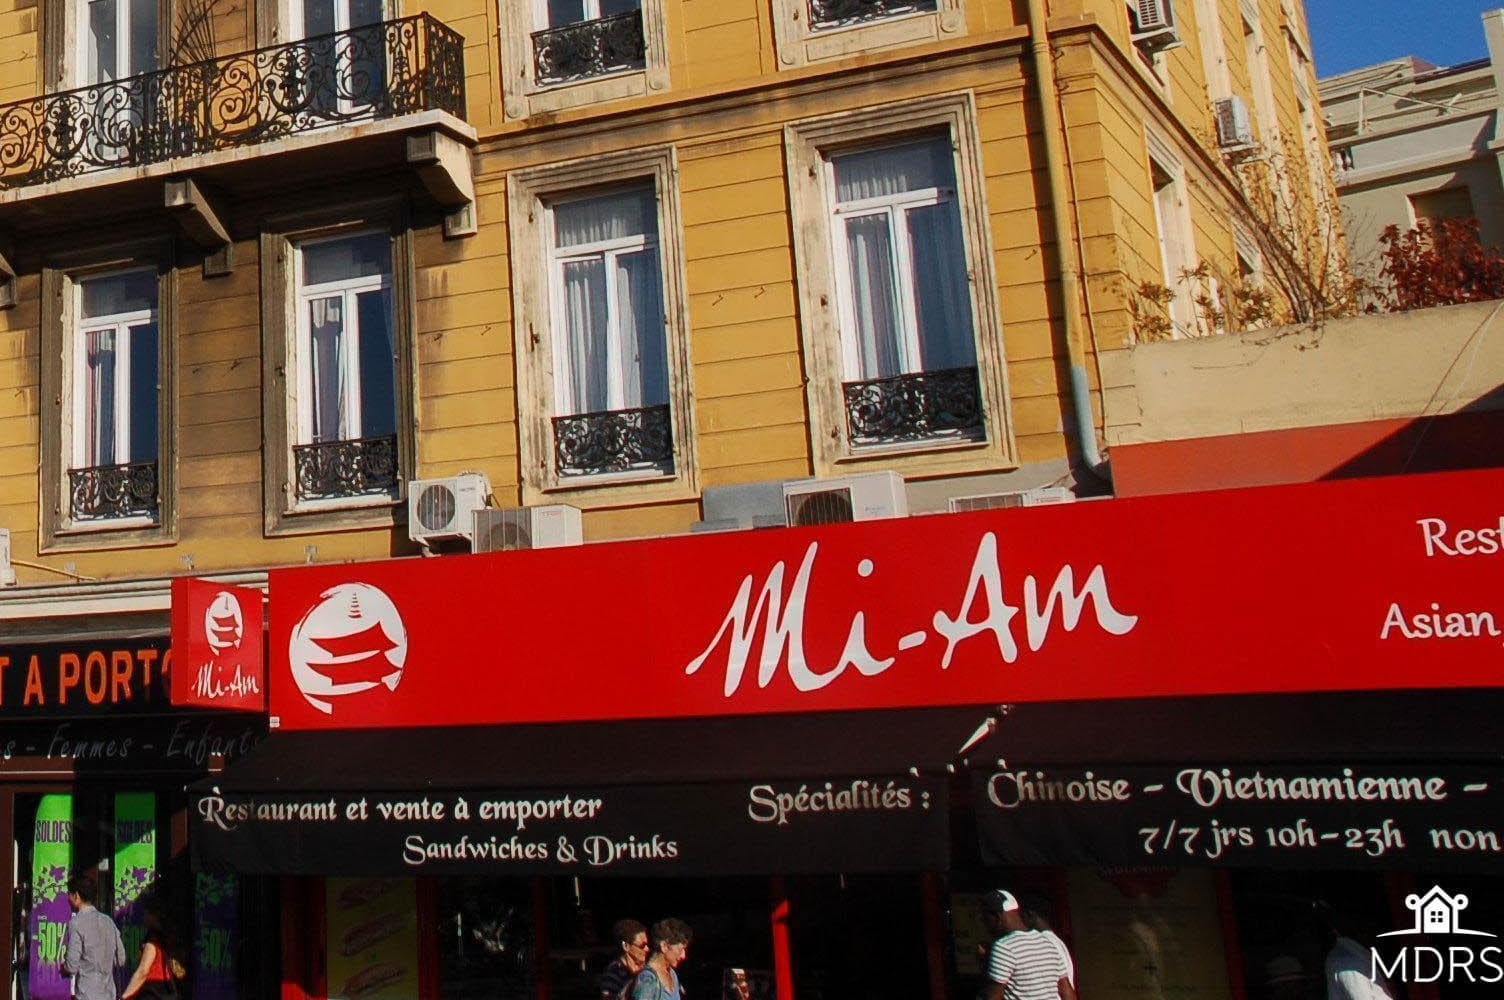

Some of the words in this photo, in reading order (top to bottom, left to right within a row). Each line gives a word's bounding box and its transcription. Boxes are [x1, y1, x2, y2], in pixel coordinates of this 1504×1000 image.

[684, 531, 1139, 698] Mi-Am
[23, 653, 45, 706] A
[191, 660, 261, 699] Mi-Am
[46, 722, 129, 760] Femmes
[747, 781, 911, 826] Spécialités
[986, 768, 1131, 810] Chinoise
[1176, 766, 1448, 810] Vietnamienne
[36, 820, 72, 843] SOLDES
[198, 796, 337, 831] Restaurant
[345, 796, 369, 821] et
[376, 798, 445, 821] vente
[453, 796, 471, 821] à
[478, 795, 603, 830] emporter
[402, 835, 549, 866] Sandwiches
[556, 837, 578, 864] &
[583, 834, 679, 867] Drinks
[1137, 820, 1200, 855] 7/7
[1205, 819, 1254, 859] jrs
[1430, 828, 1502, 851] non
